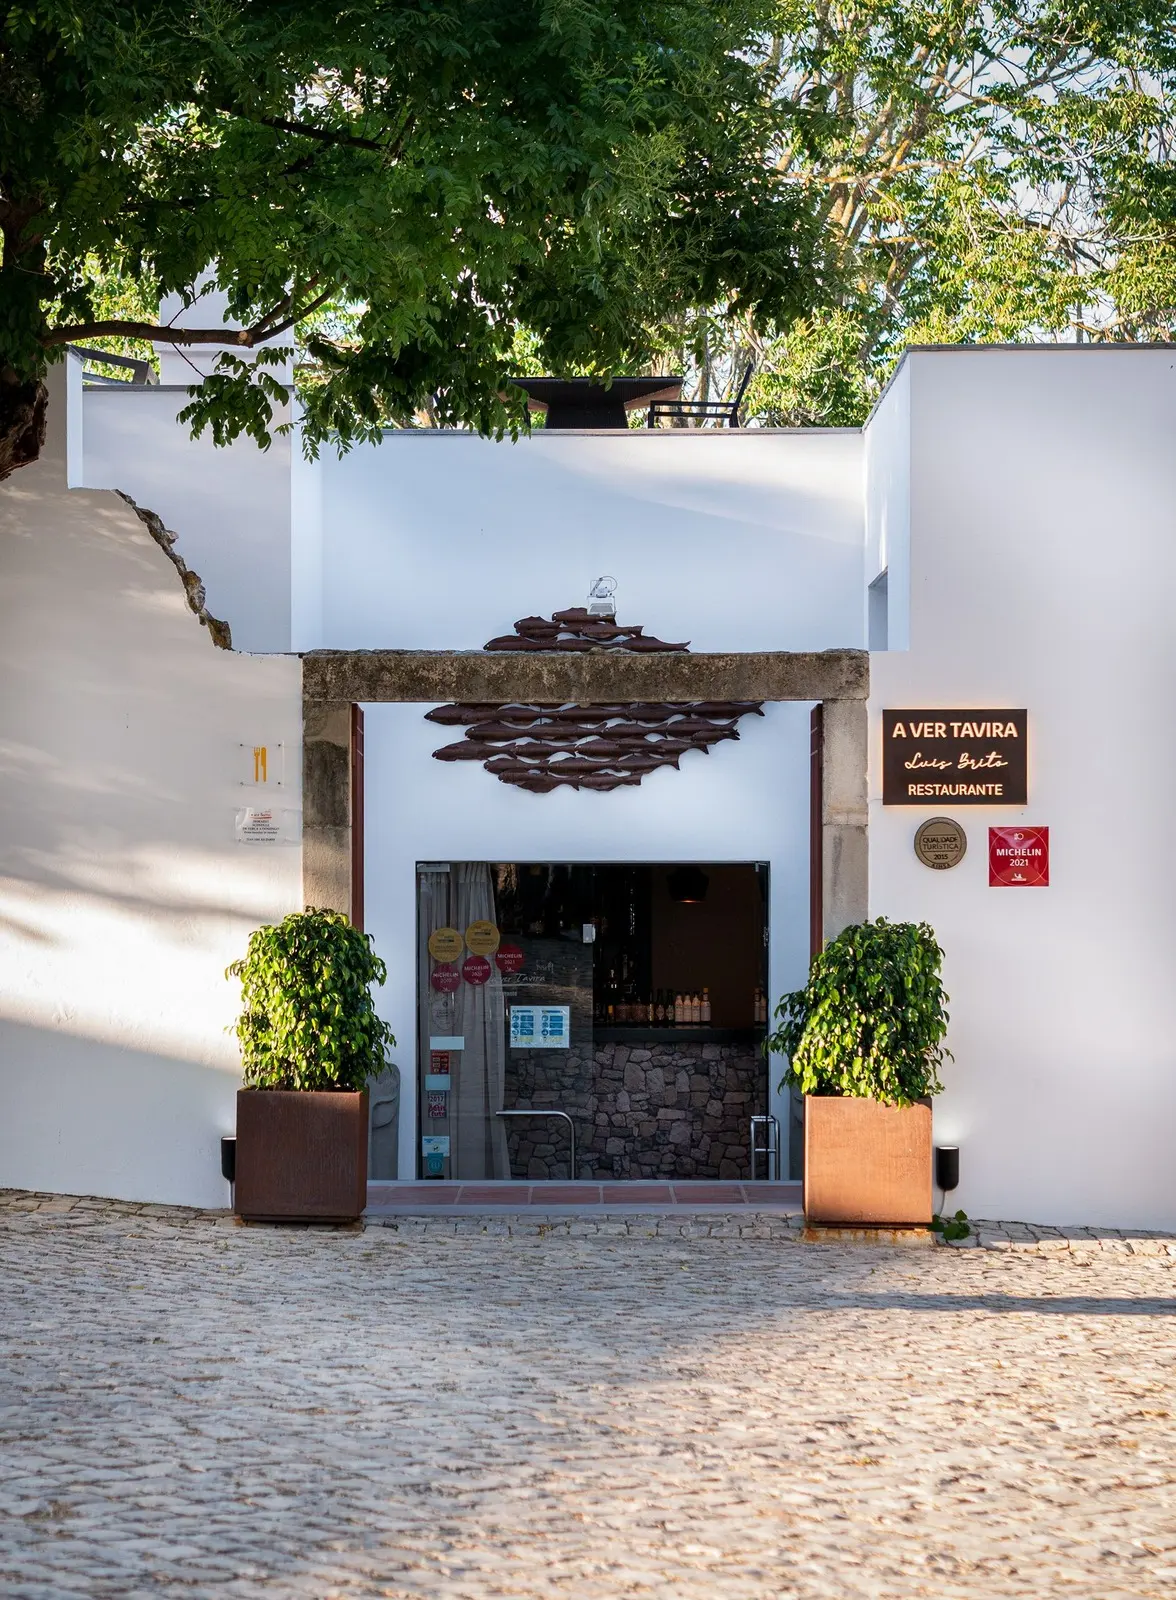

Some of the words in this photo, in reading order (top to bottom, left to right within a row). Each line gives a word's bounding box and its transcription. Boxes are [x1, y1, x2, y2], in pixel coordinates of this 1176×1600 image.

[892, 722, 907, 738] A
[909, 722, 947, 738] VER
[949, 722, 1018, 738] TAVIRA
[957, 751, 1008, 770] Brito
[908, 784, 1003, 796] RESTAURANTE
[996, 848, 1042, 856] MICHELIN
[1009, 858, 1029, 866] 2021
[516, 972, 546, 983] Tavira
